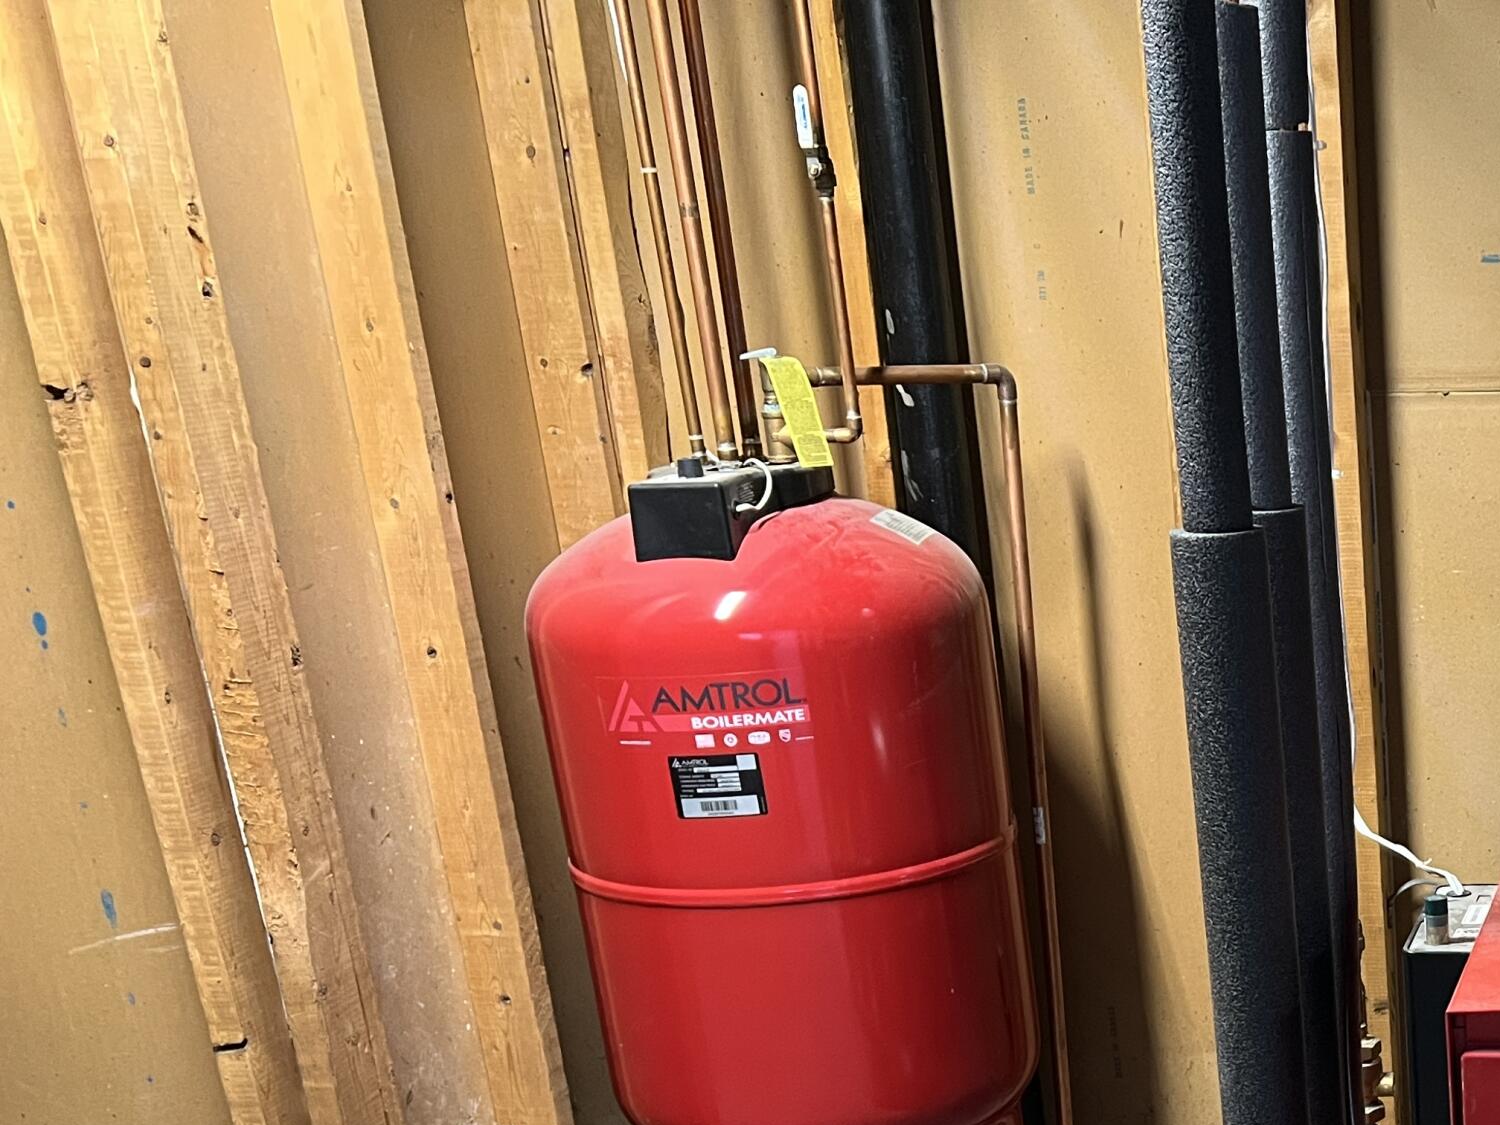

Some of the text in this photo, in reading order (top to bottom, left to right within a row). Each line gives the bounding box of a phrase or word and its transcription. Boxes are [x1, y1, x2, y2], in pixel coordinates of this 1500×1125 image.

[1025, 167, 1035, 195] MADE
[652, 678, 804, 714] AMTROL
[691, 708, 806, 730] BOILERMATE
